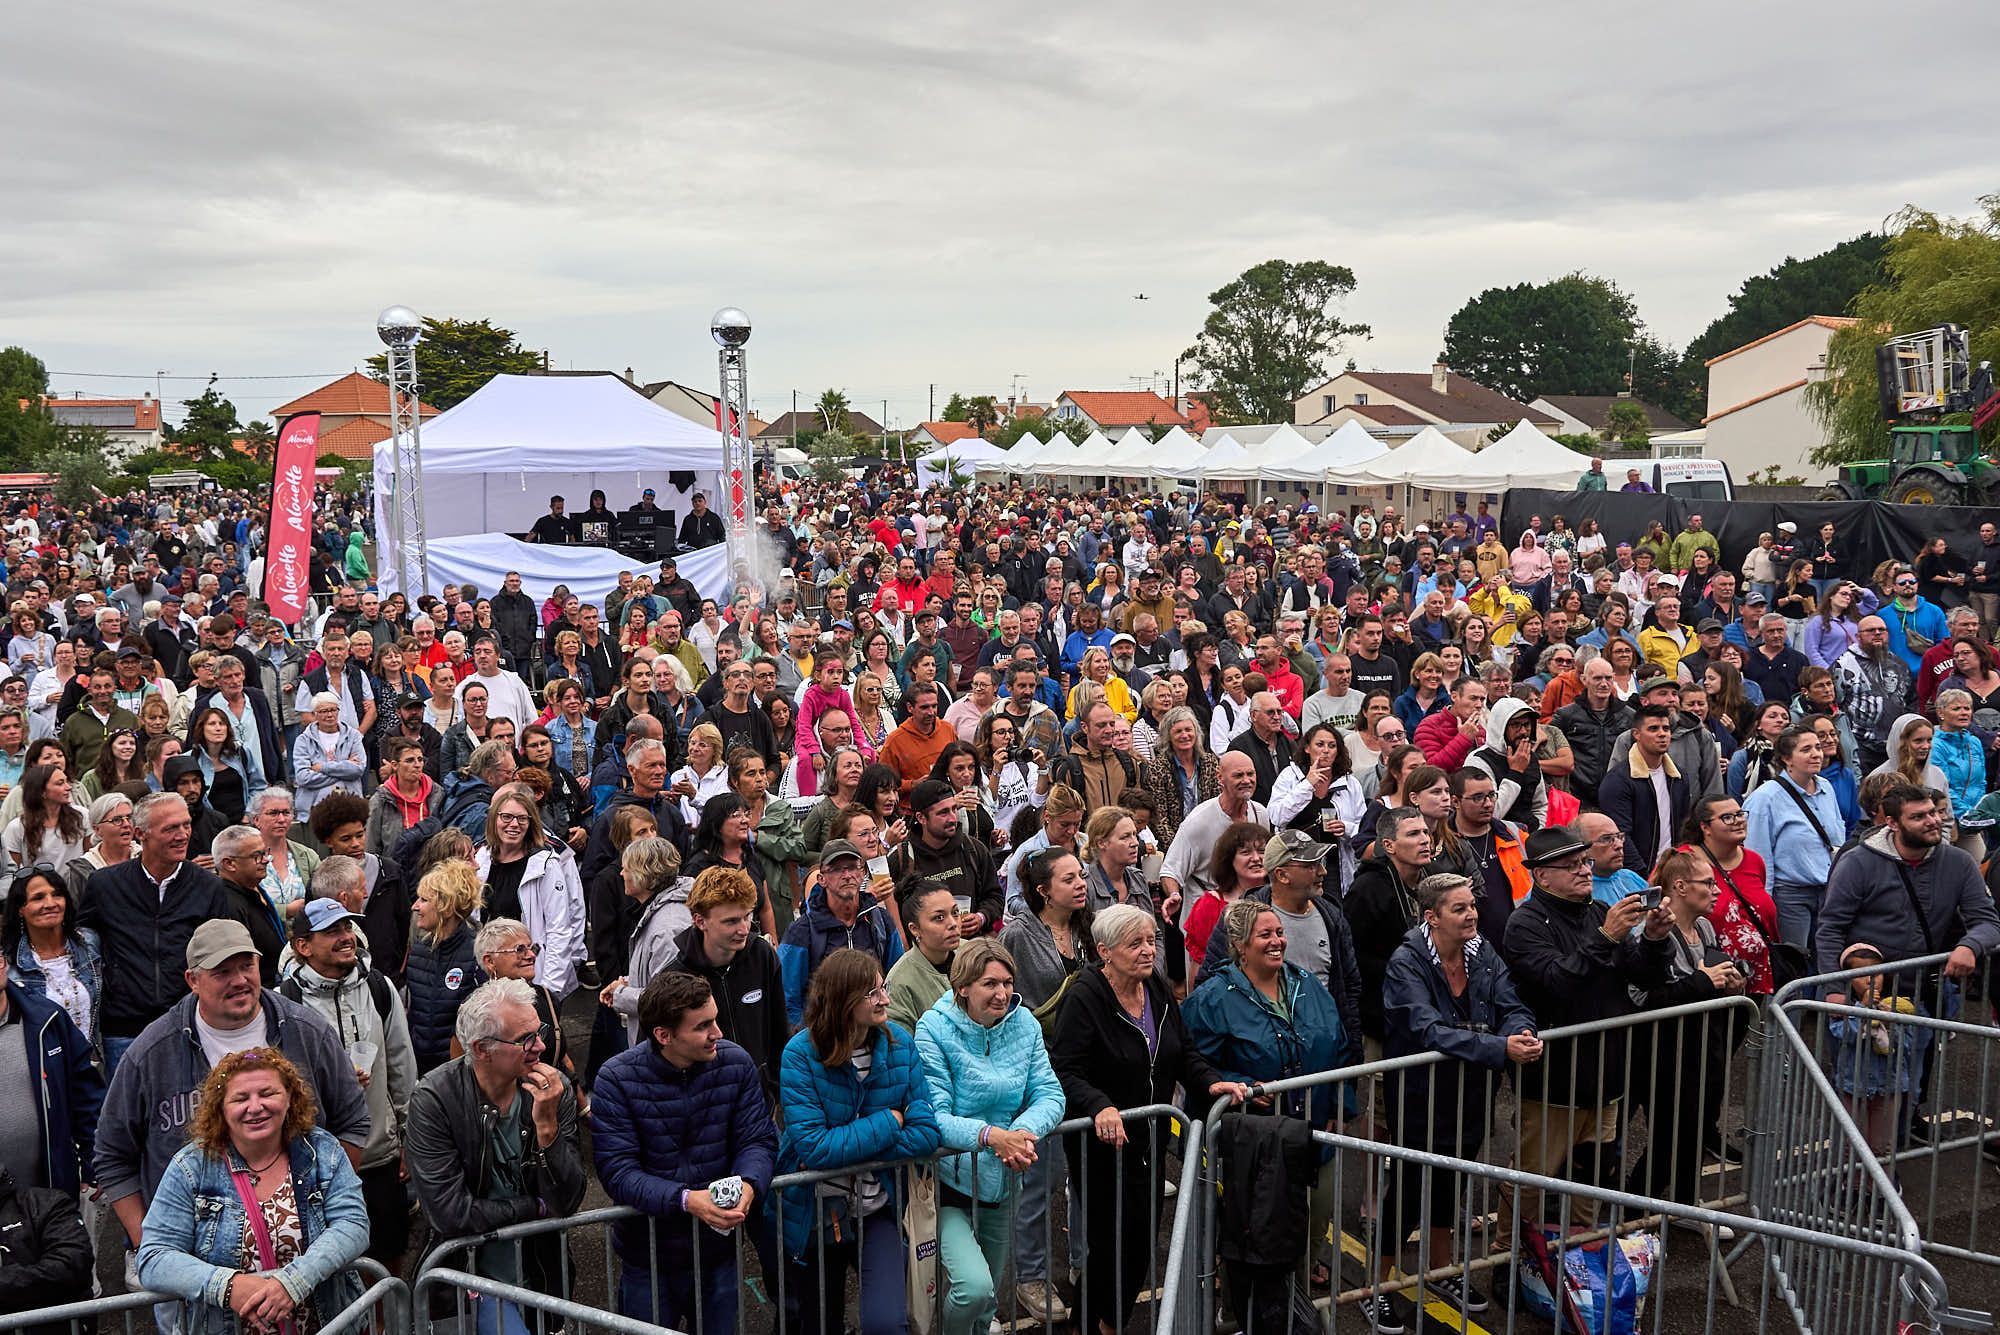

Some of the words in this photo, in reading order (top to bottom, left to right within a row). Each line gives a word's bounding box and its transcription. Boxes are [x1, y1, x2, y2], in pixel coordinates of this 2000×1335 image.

[287, 434, 314, 445] Alouette
[285, 464, 305, 532] Alouette
[278, 544, 302, 609] Alouette
